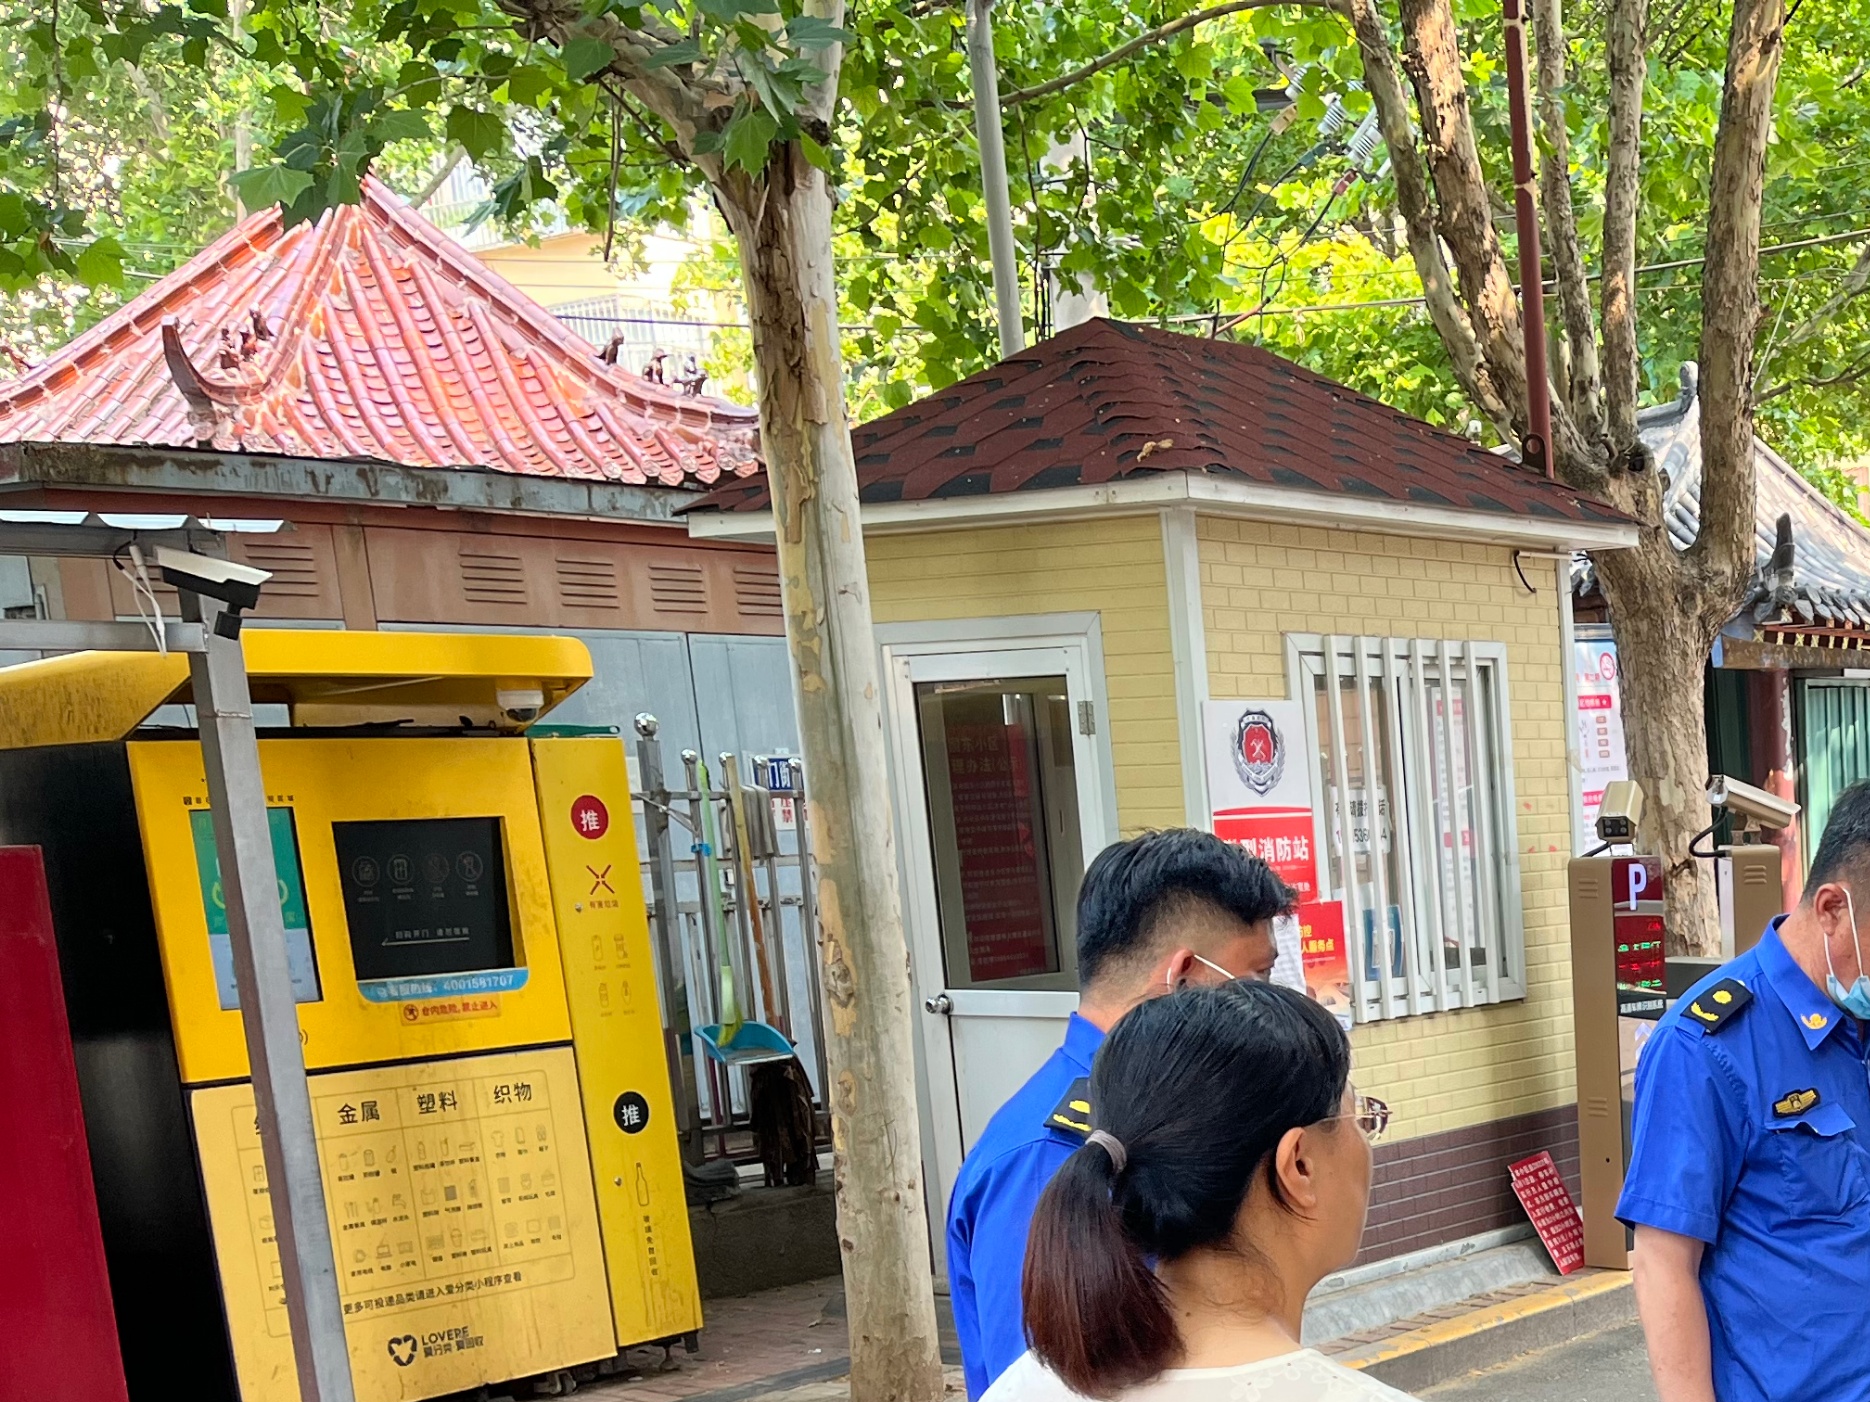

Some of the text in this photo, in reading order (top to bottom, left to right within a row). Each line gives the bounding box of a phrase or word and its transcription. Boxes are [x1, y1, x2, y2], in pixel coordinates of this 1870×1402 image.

[580, 809, 600, 831] 推
[1628, 863, 1647, 911] P
[337, 1082, 532, 1125] 金属 塑料 织物
[621, 1104, 641, 1127] 推
